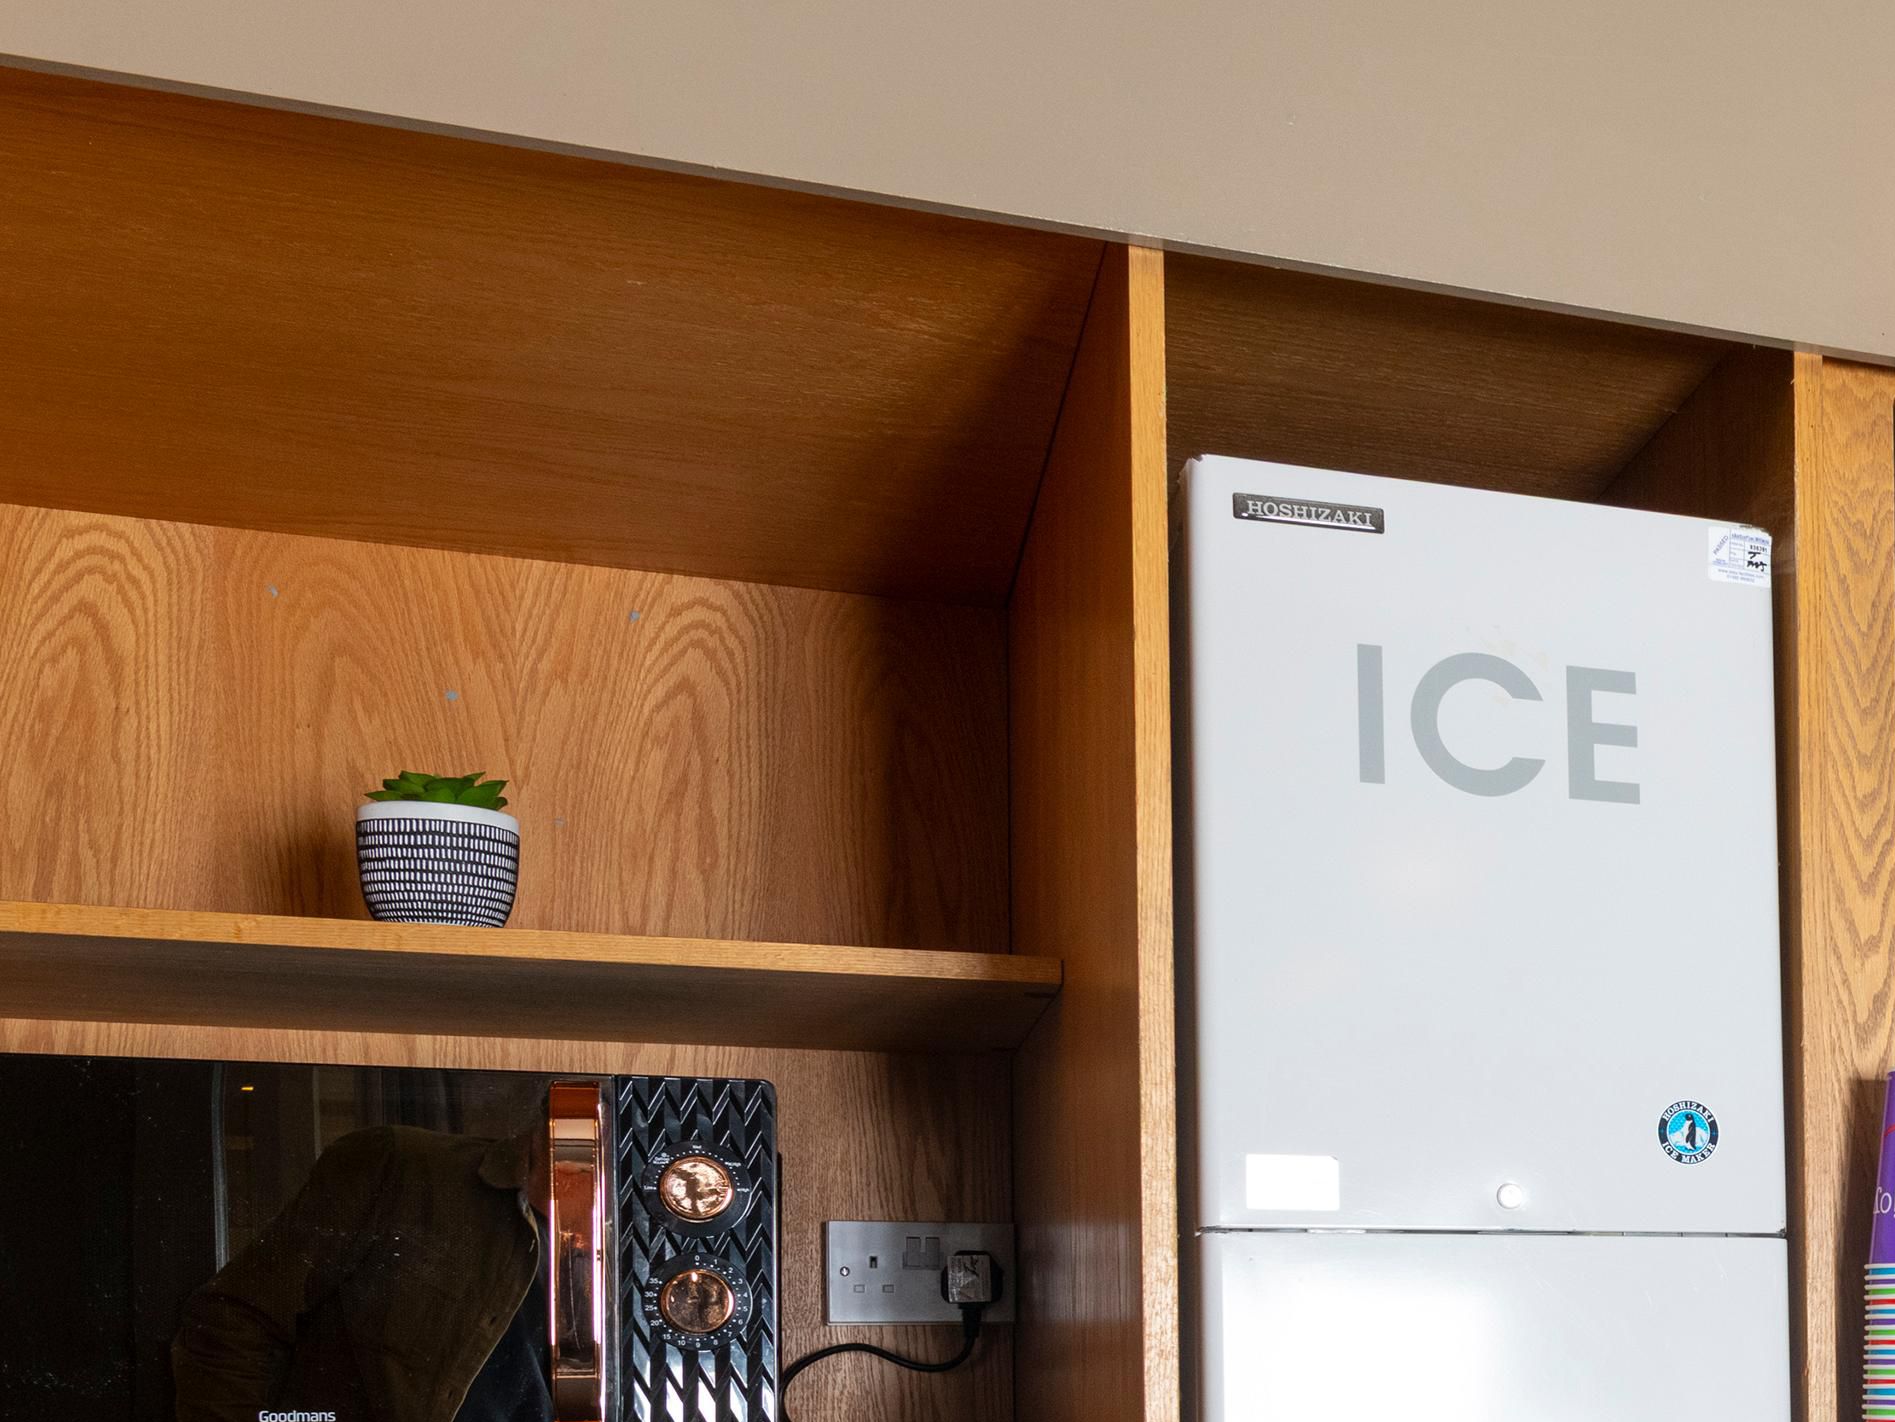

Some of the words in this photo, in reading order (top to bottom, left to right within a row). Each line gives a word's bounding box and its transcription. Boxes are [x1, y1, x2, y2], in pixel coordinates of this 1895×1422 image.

[1247, 499, 1373, 527] HOSHIZAKI
[1357, 643, 1641, 806] ICE
[1662, 1101, 1714, 1123] HOSHIZAKI
[1662, 1142, 1679, 1160] ICE
[1681, 1143, 1715, 1164] MAKER
[258, 1410, 336, 1422] Goodmans
